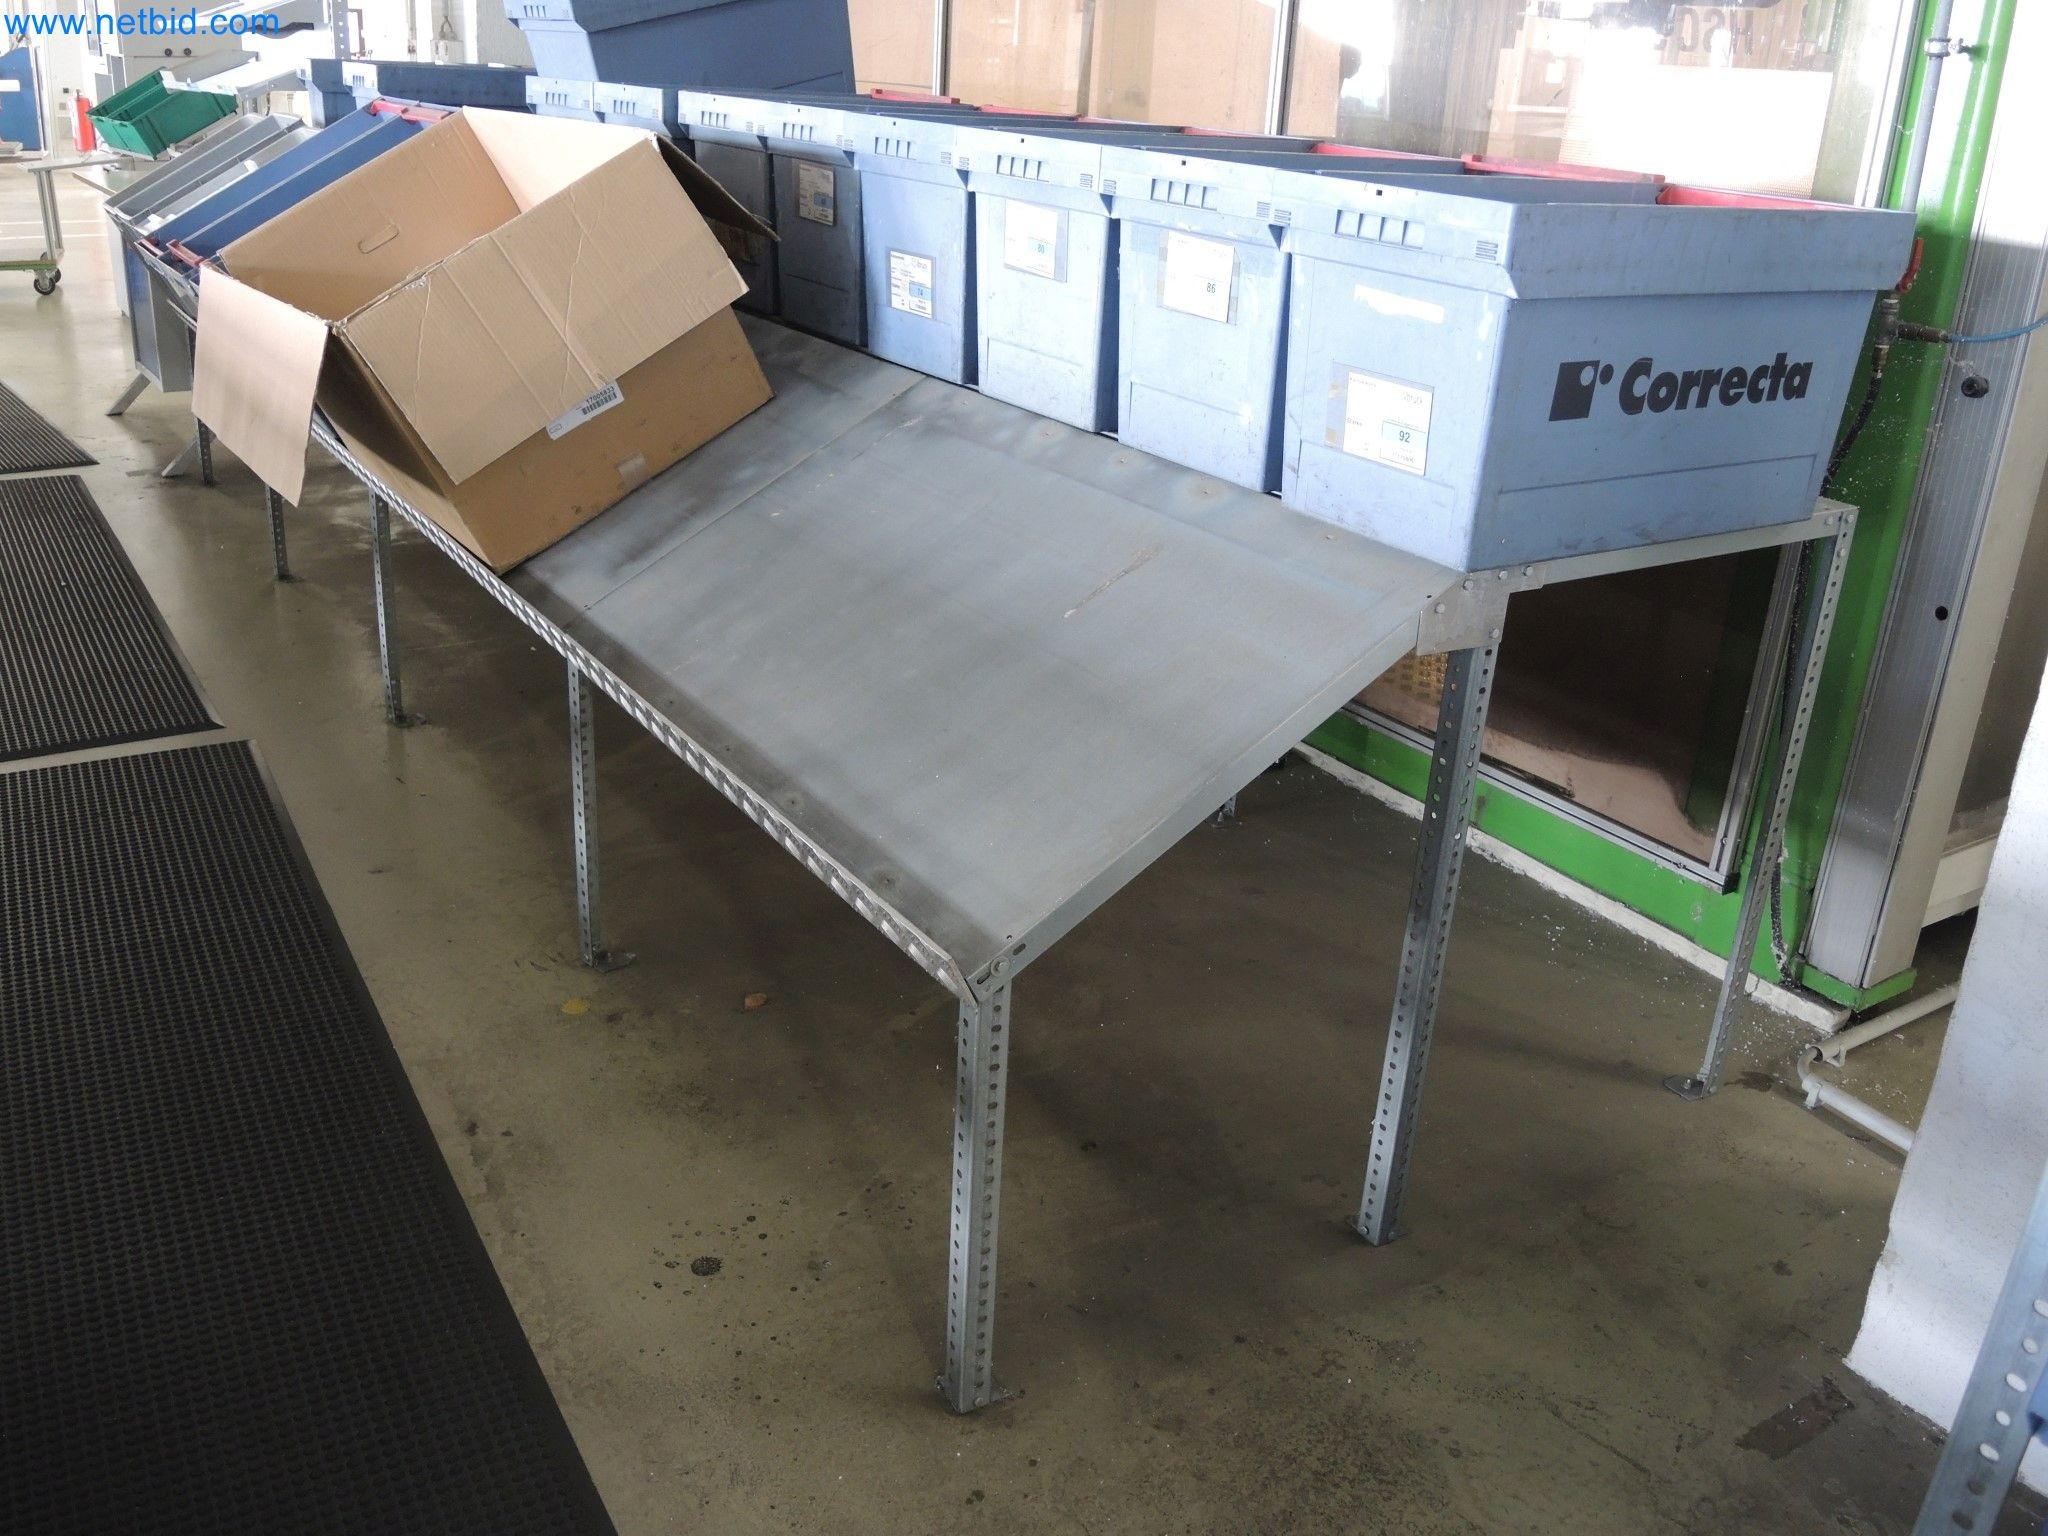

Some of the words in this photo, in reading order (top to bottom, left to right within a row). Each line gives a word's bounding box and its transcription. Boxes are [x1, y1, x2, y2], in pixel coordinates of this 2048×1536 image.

[1206, 282, 1216, 294] 86
[1618, 352, 1813, 415] Correcta
[1399, 430, 1411, 444] 92
